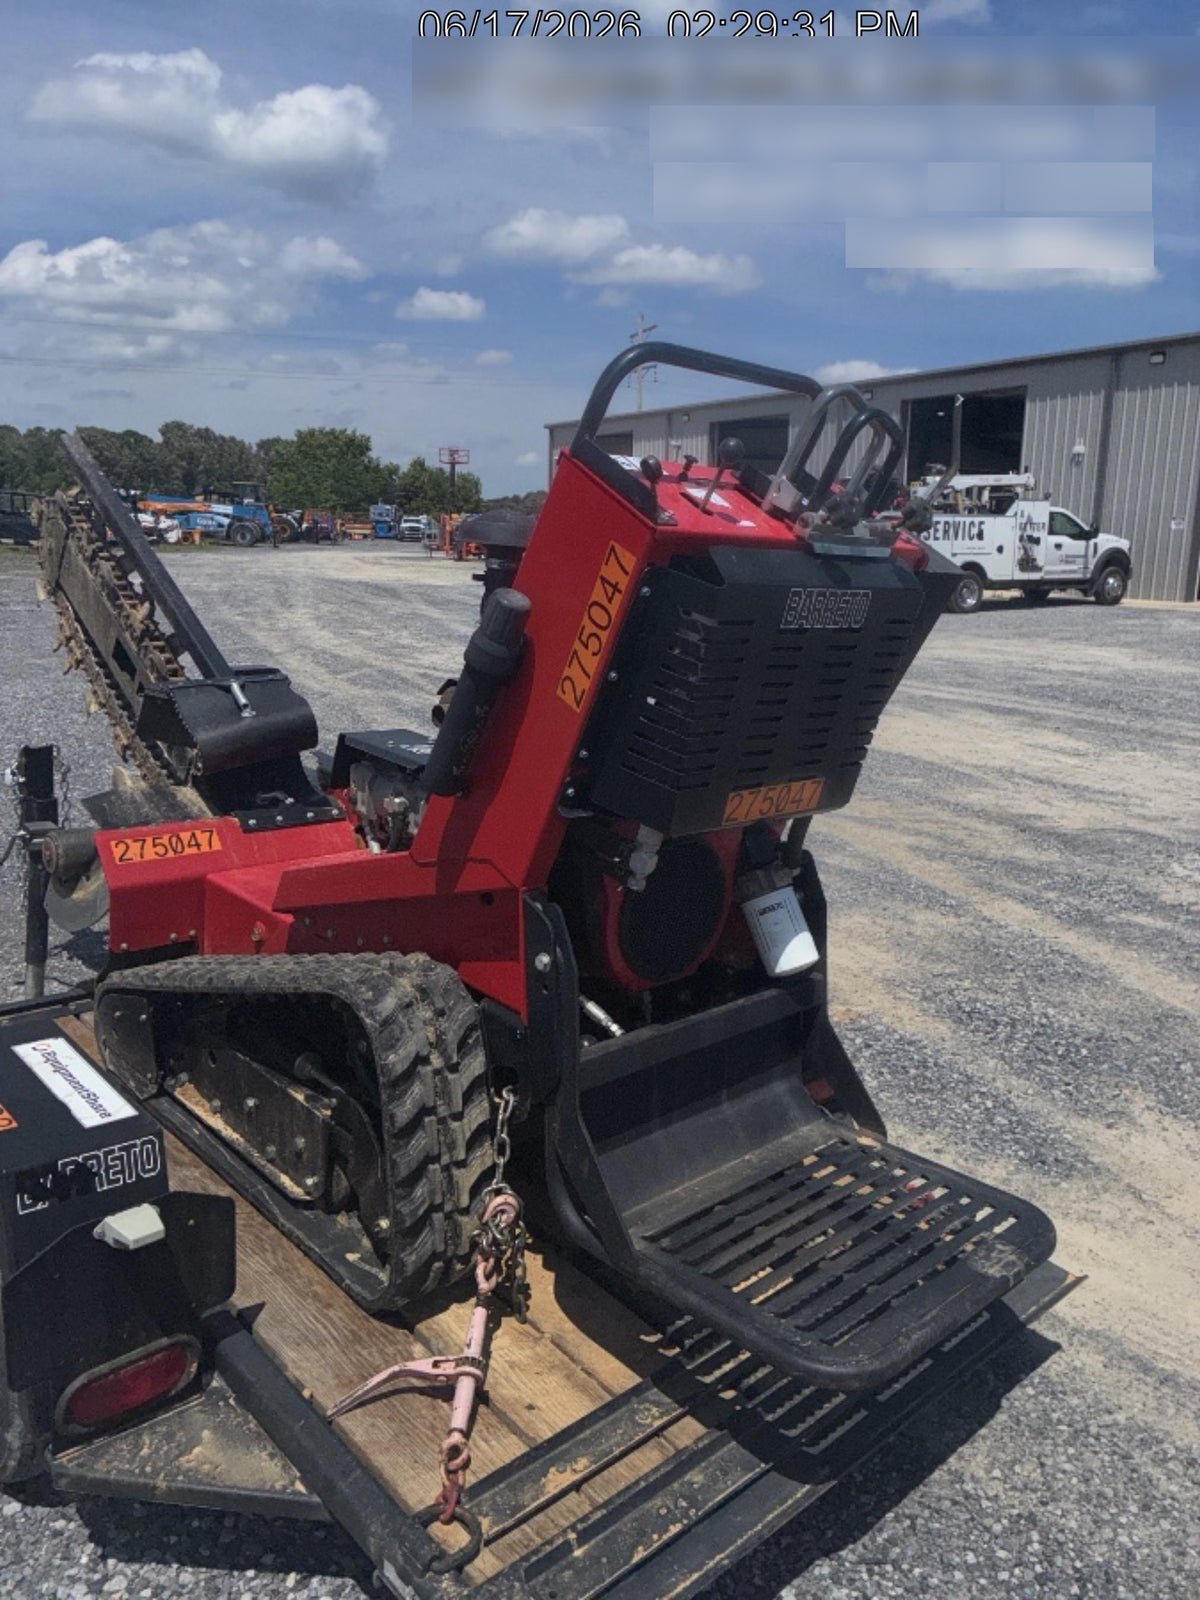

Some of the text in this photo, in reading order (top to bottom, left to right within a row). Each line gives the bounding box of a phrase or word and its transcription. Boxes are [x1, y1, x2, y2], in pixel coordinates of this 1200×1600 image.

[561, 543, 630, 709] 275047
[780, 587, 872, 629] BARRETO
[724, 779, 822, 823] 275047
[114, 829, 214, 863] 275047
[41, 1050, 113, 1119] EquipmentShare
